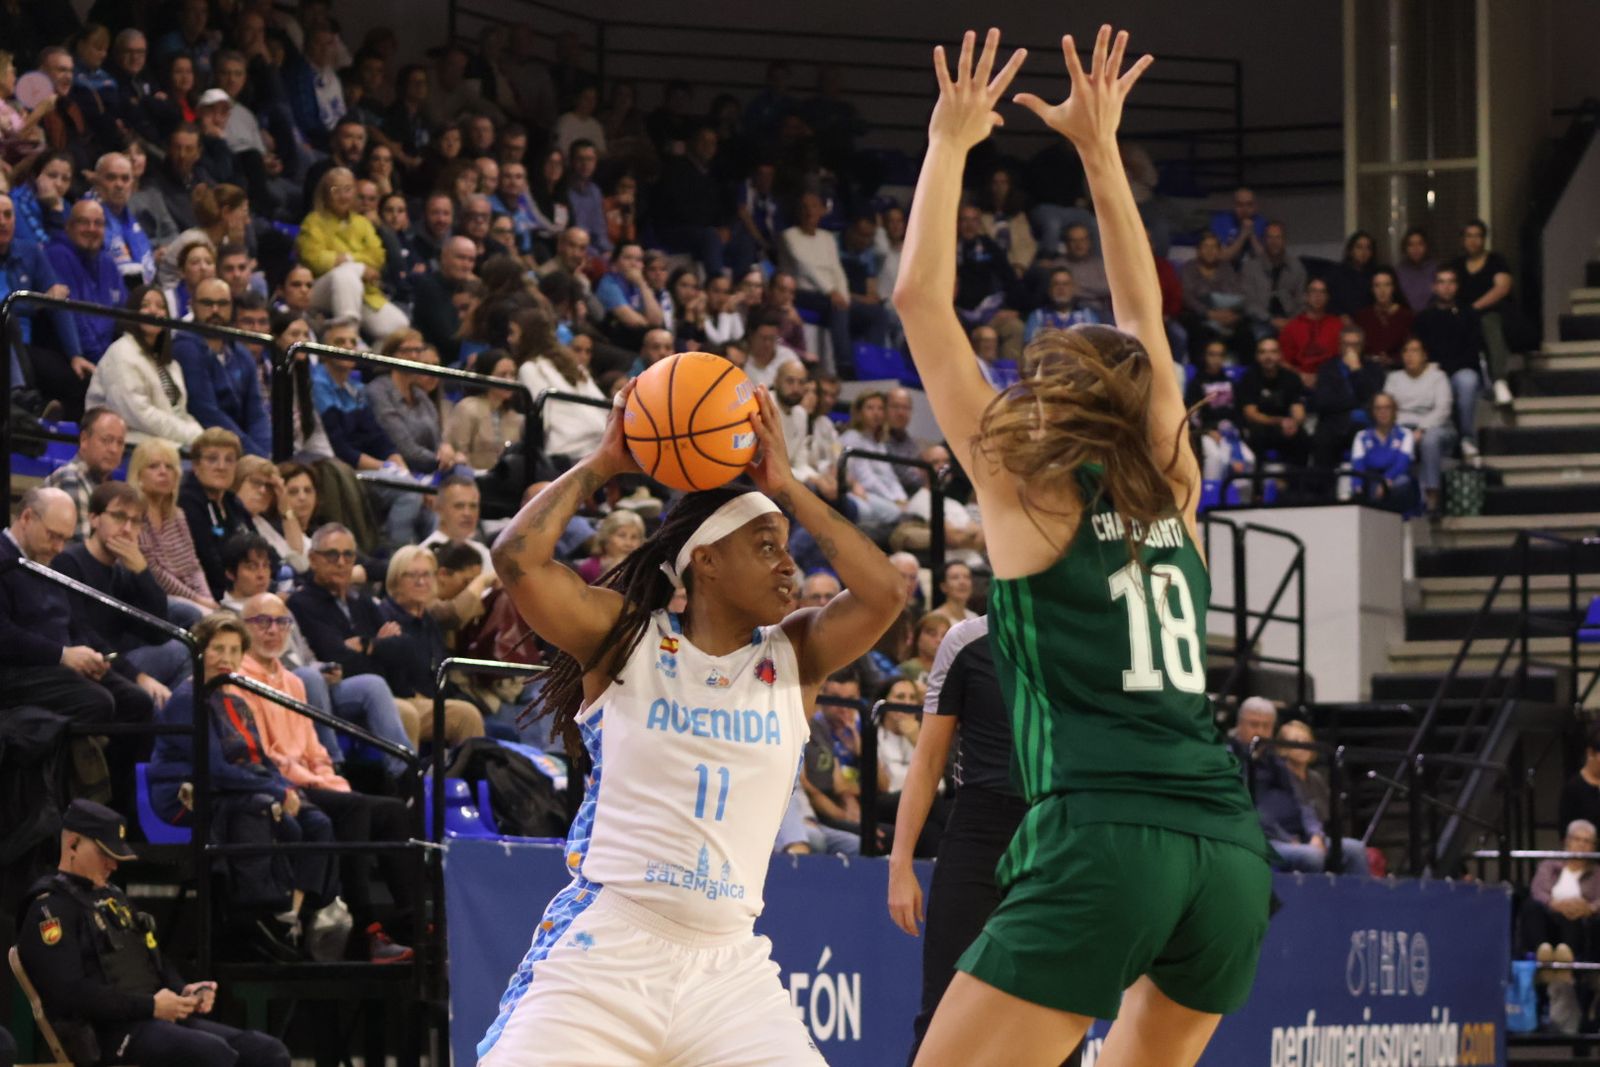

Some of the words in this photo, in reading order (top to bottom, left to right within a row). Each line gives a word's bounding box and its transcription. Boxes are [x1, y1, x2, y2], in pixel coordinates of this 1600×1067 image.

[1108, 560, 1206, 694] 18
[647, 698, 781, 745] AVENIDA
[695, 763, 730, 821] 11
